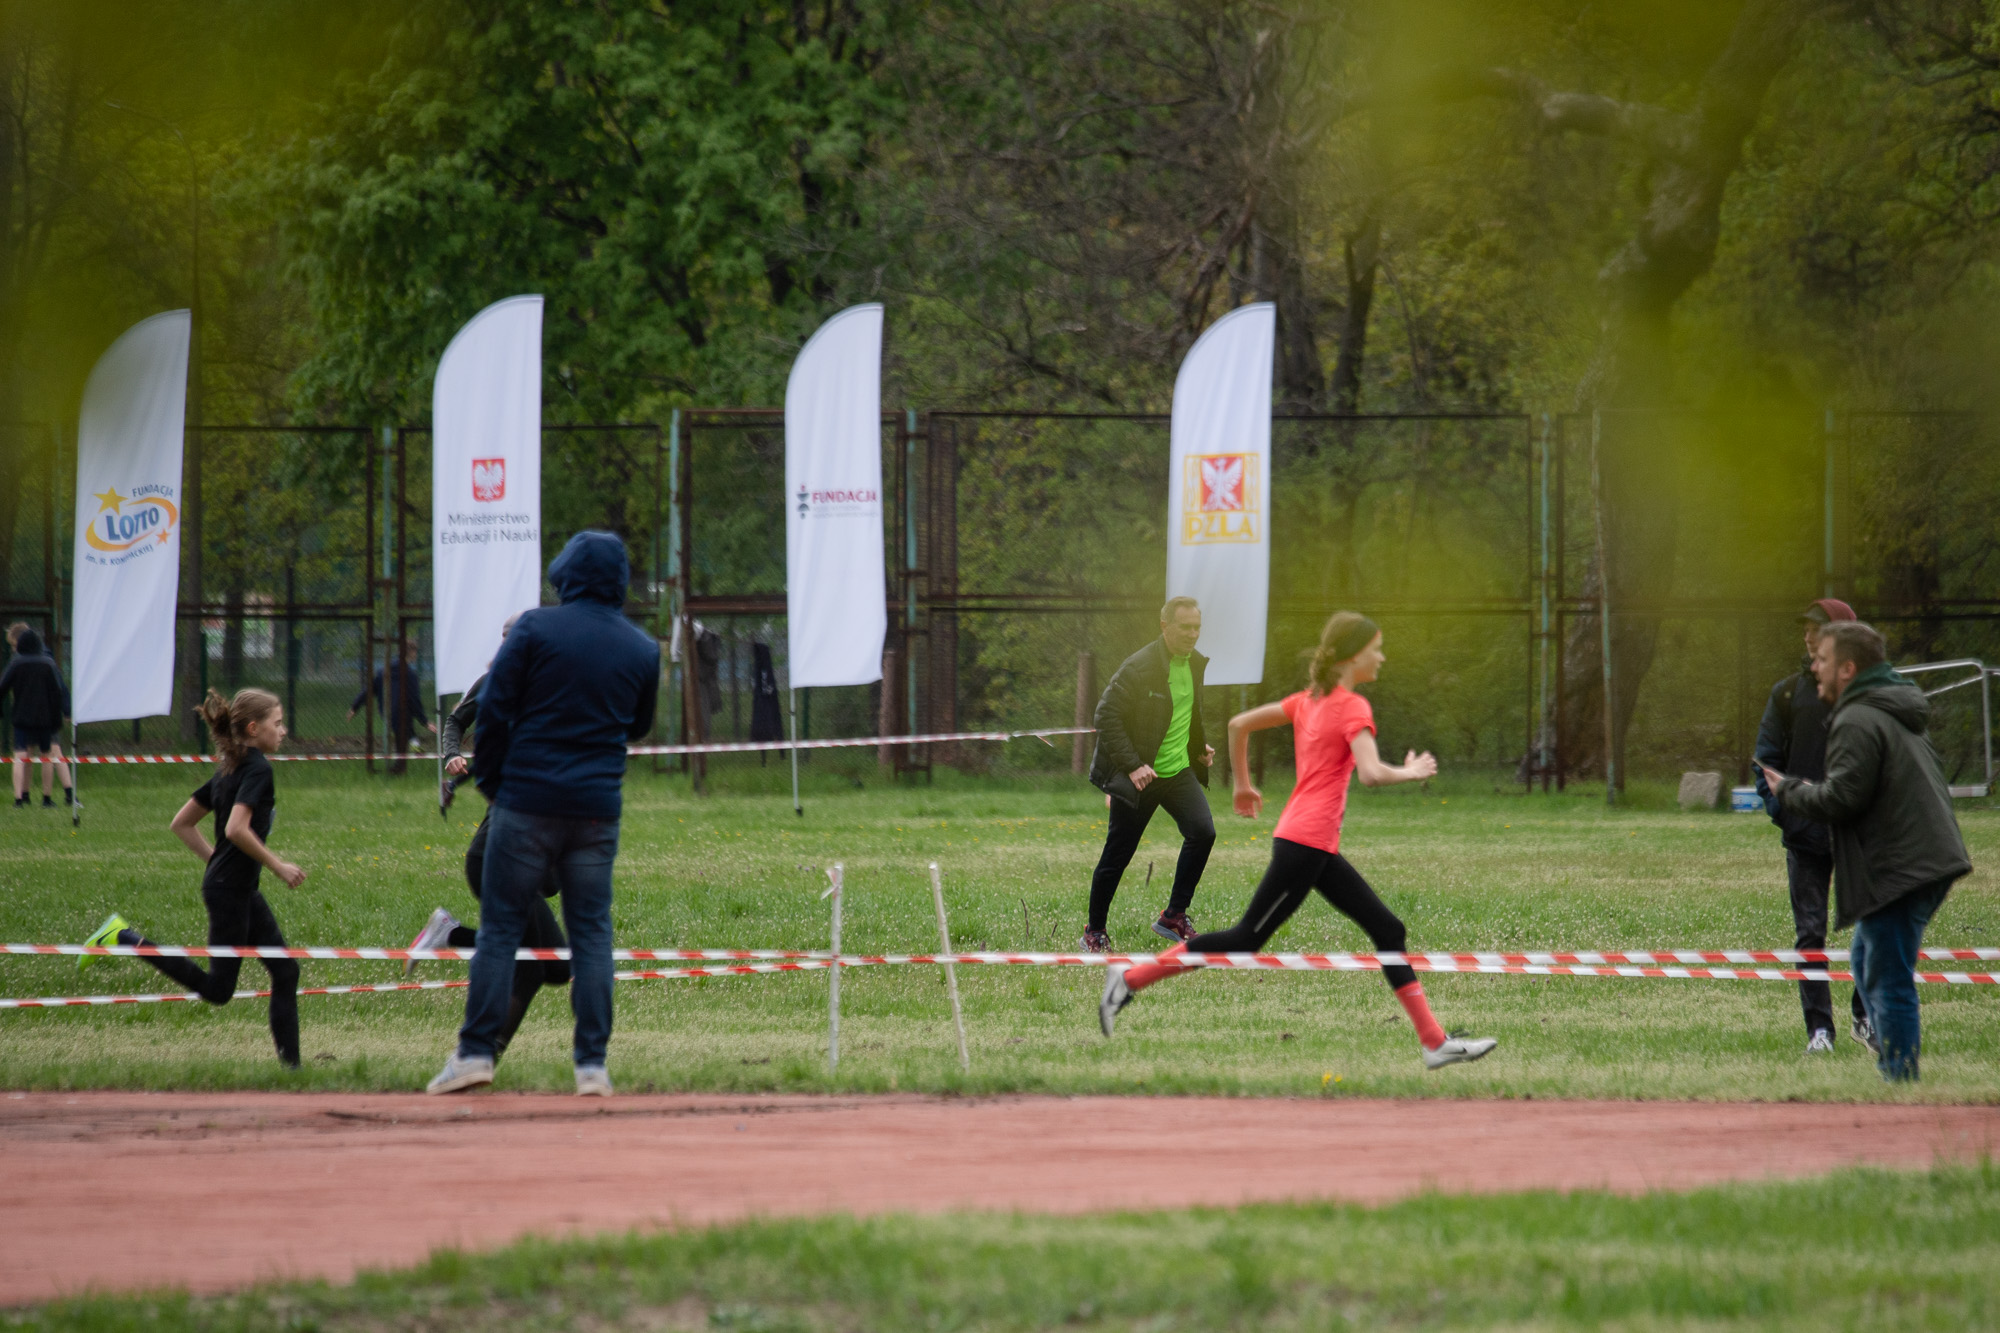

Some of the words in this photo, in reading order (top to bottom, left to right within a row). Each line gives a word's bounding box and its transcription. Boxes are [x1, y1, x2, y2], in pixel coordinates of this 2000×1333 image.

[132, 484, 174, 498] FUNDACJA
[106, 507, 159, 541] LOTTO
[448, 512, 530, 526] Ministerstwo
[1188, 514, 1253, 539] PZLA
[500, 529, 537, 542] Nauki
